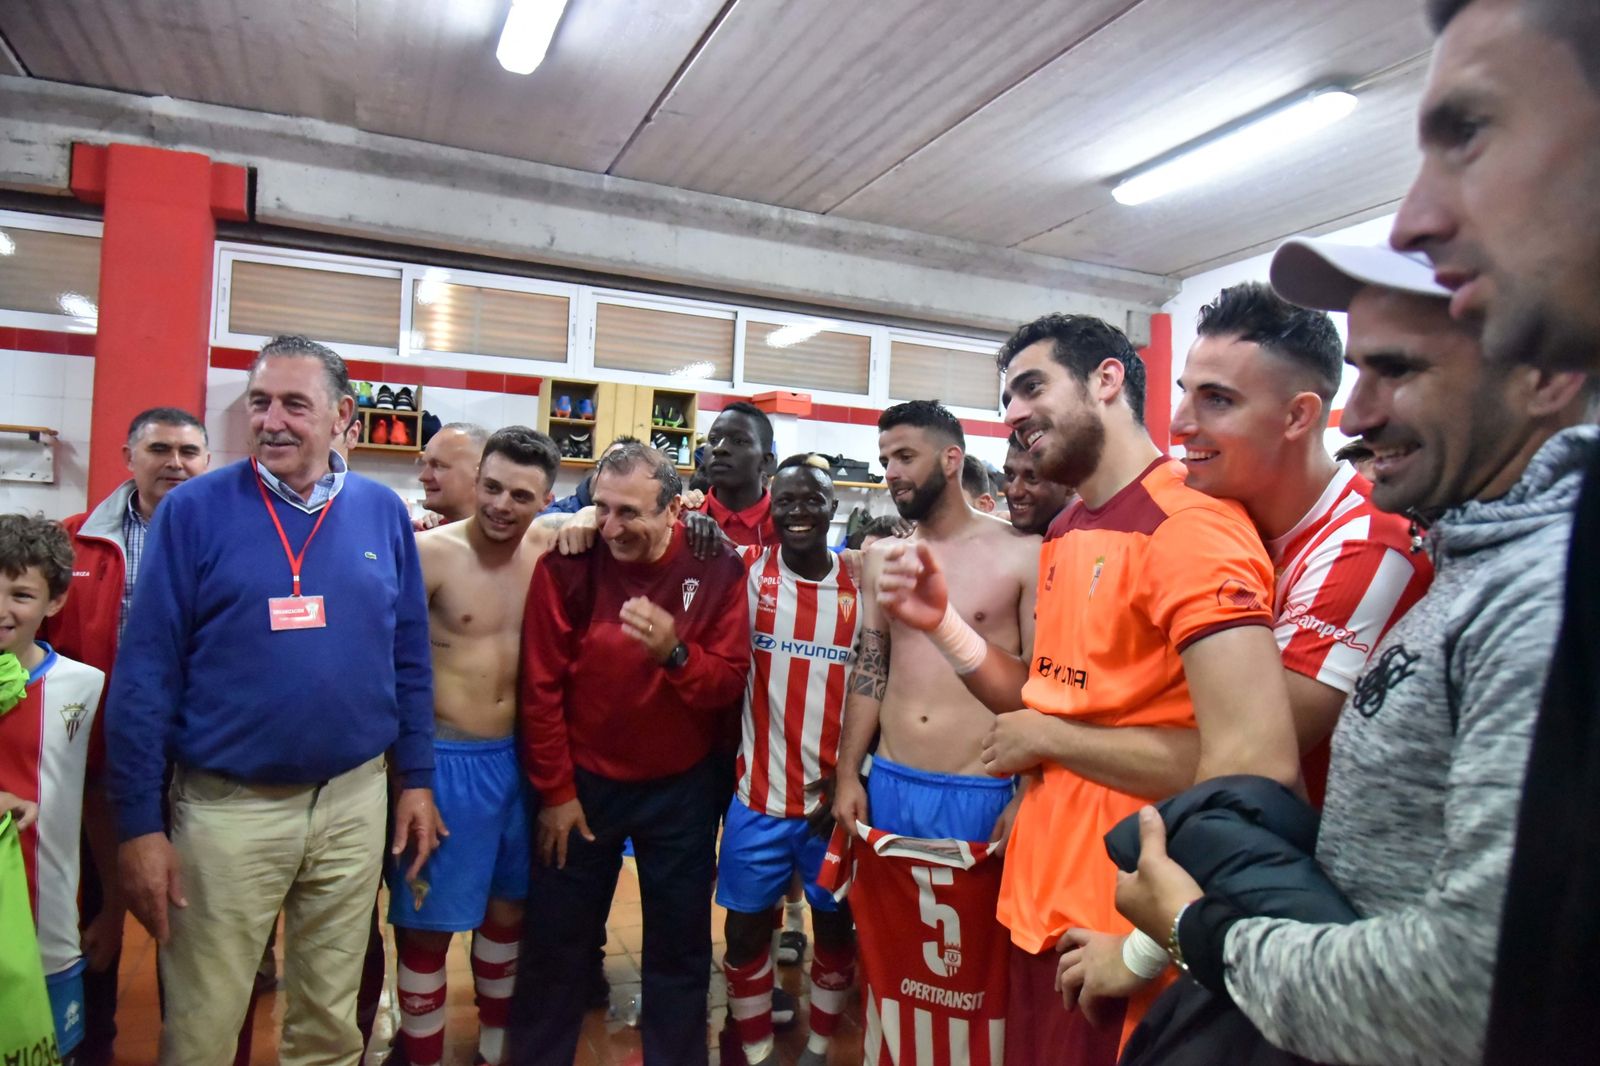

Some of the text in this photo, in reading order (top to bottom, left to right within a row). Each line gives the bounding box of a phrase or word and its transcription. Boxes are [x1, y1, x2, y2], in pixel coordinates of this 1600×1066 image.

[781, 641, 851, 662] HYUNDAI
[911, 866, 962, 977] 5
[900, 977, 986, 1012] OPERTRANSIT
